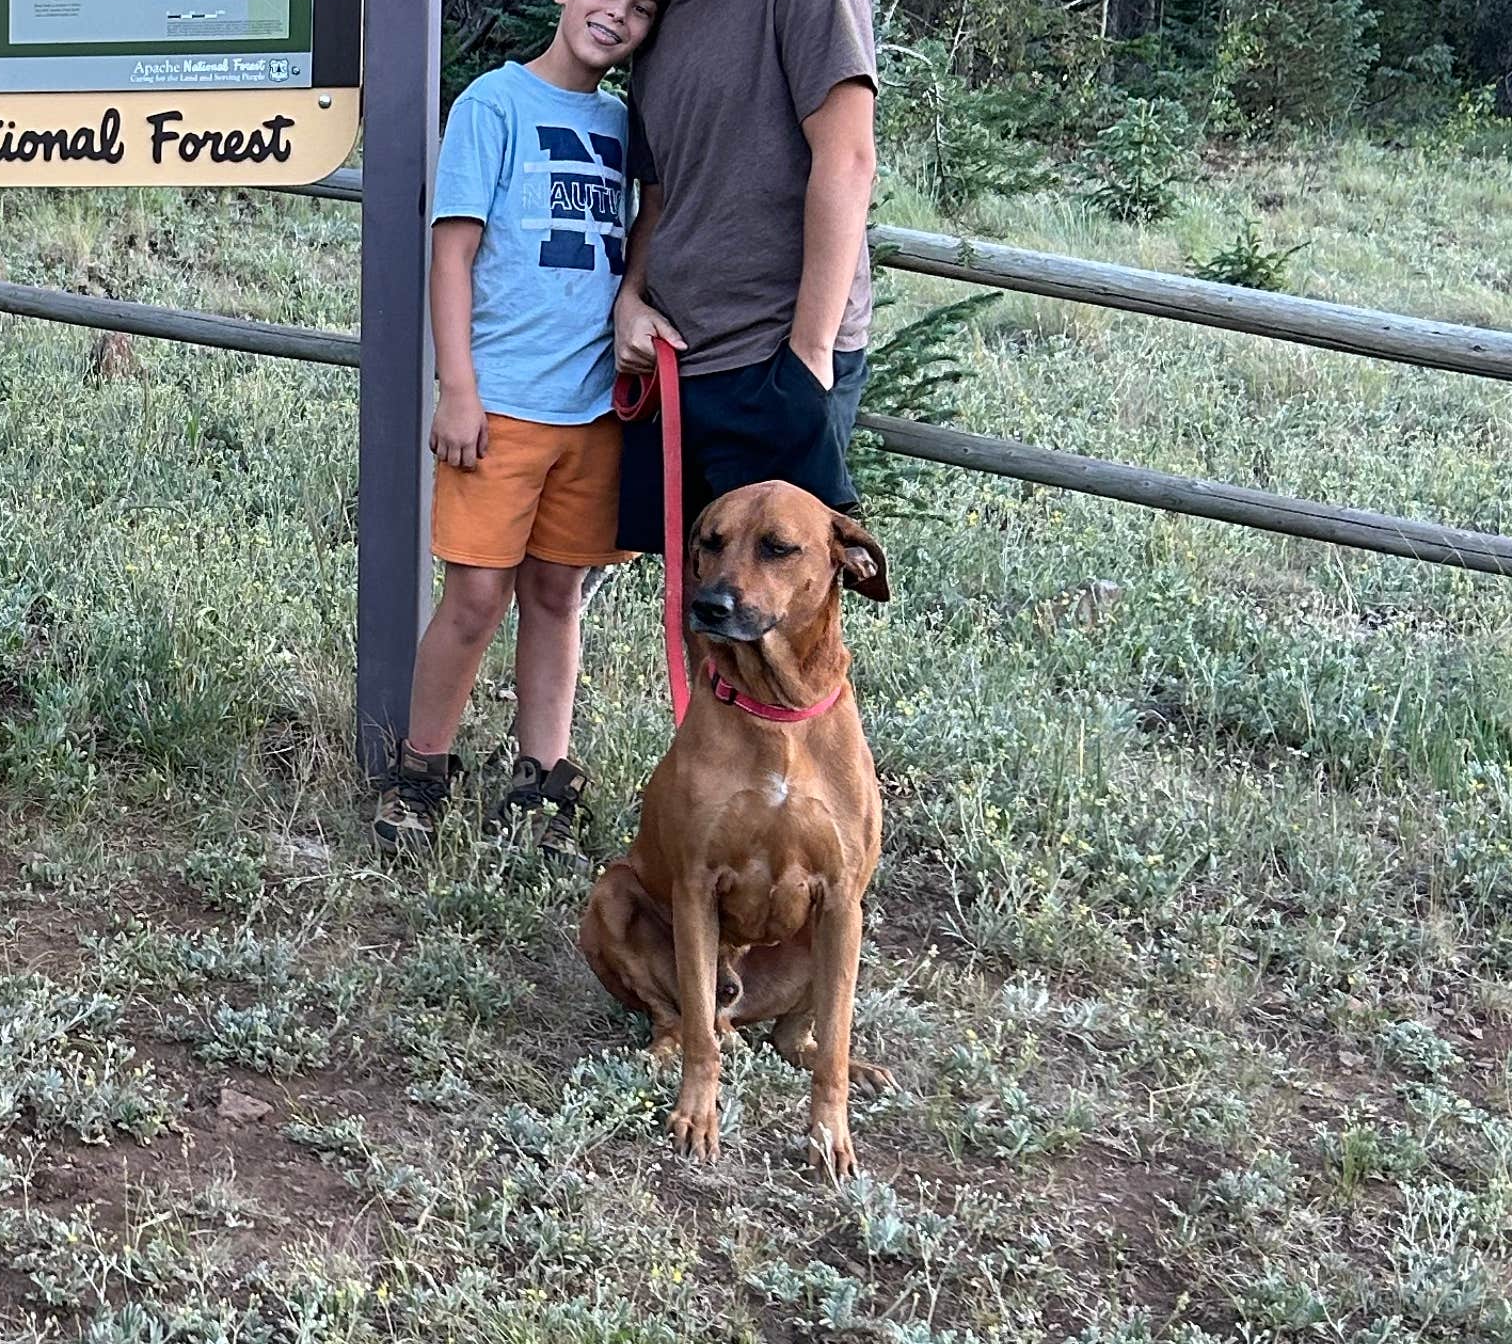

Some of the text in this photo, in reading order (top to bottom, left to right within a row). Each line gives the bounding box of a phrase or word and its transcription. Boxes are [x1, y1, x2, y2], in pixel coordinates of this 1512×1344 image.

[130, 72, 266, 83] Caring for the Land and Serving People
[134, 58, 266, 75] Apache National Forest
[146, 110, 295, 164] Forest
[523, 182, 621, 215] NAUTI
